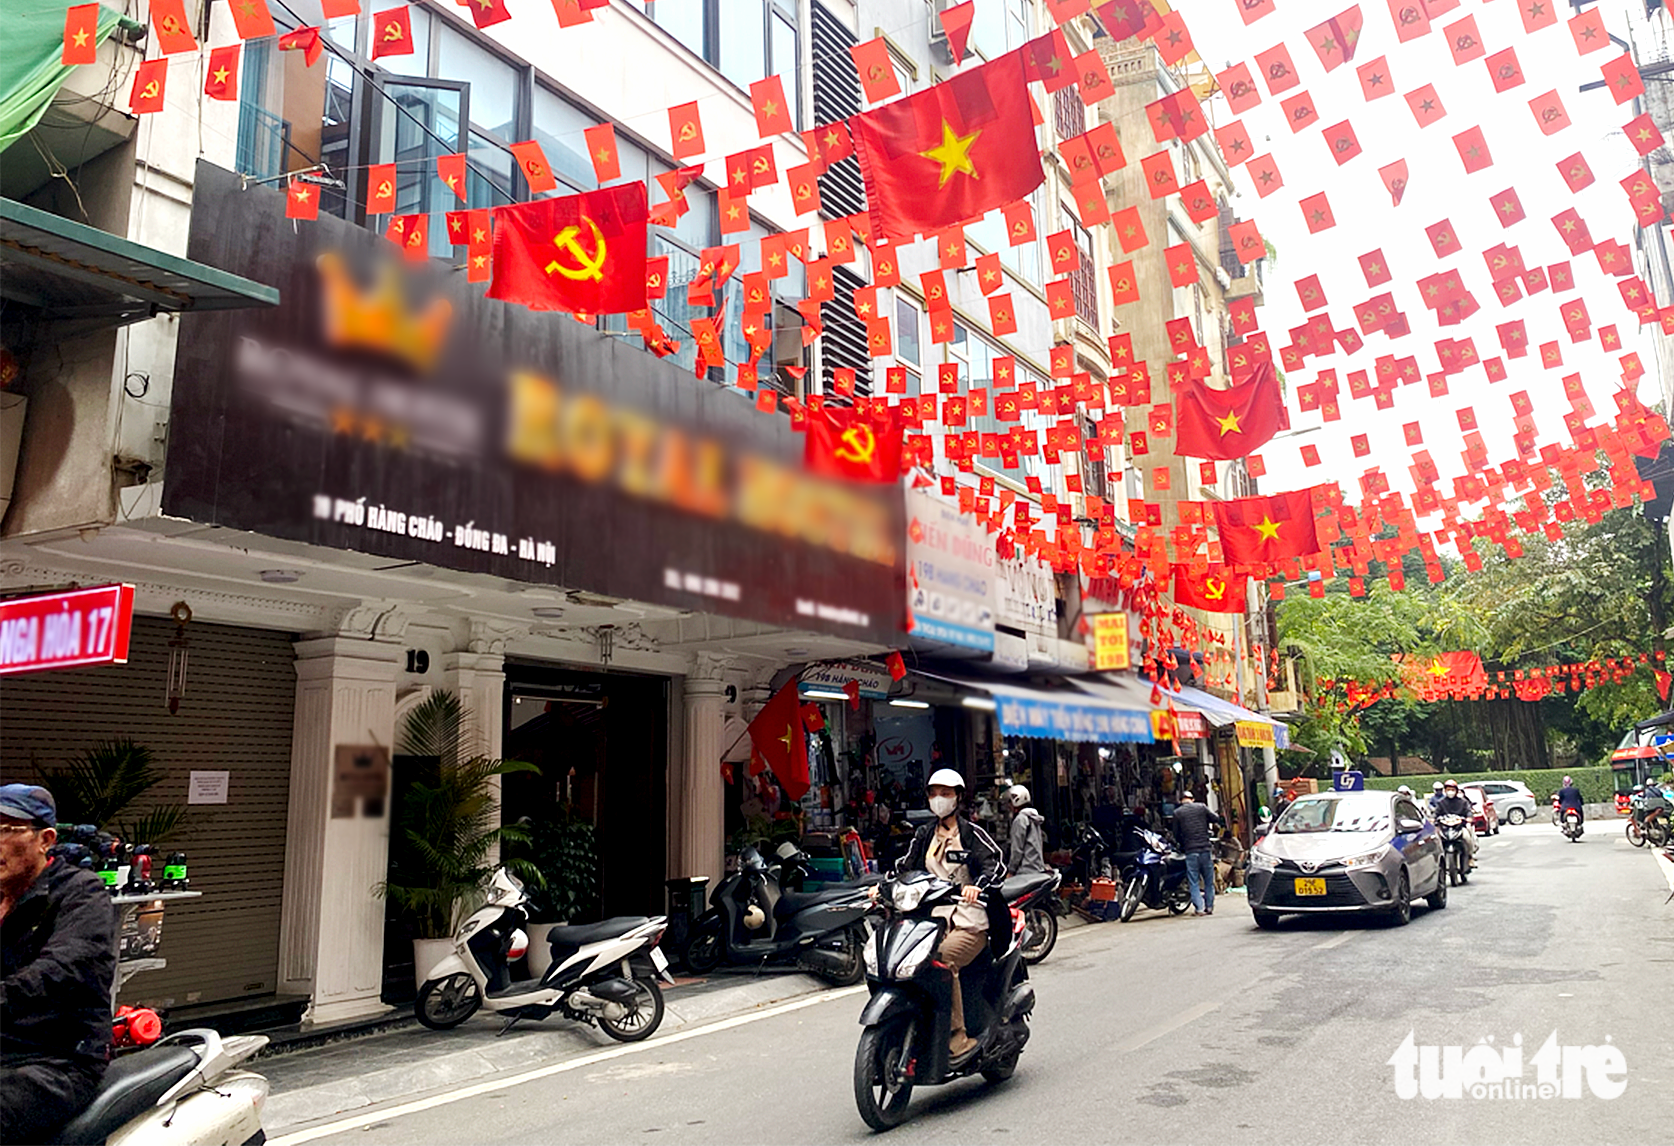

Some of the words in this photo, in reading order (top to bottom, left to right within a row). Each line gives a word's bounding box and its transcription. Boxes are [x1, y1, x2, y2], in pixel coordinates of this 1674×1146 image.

[334, 497, 366, 526] PHỐ
[367, 504, 407, 535] HÀNG
[408, 515, 443, 542] CHÁO
[454, 520, 490, 552] ĐỐNG
[491, 532, 508, 555] ĐA
[519, 536, 535, 560] HÀ
[0, 615, 39, 665] NGA
[41, 600, 82, 660] HÒA
[87, 606, 113, 655] 17
[405, 649, 430, 675] 19
[1340, 774, 1356, 789] G7
